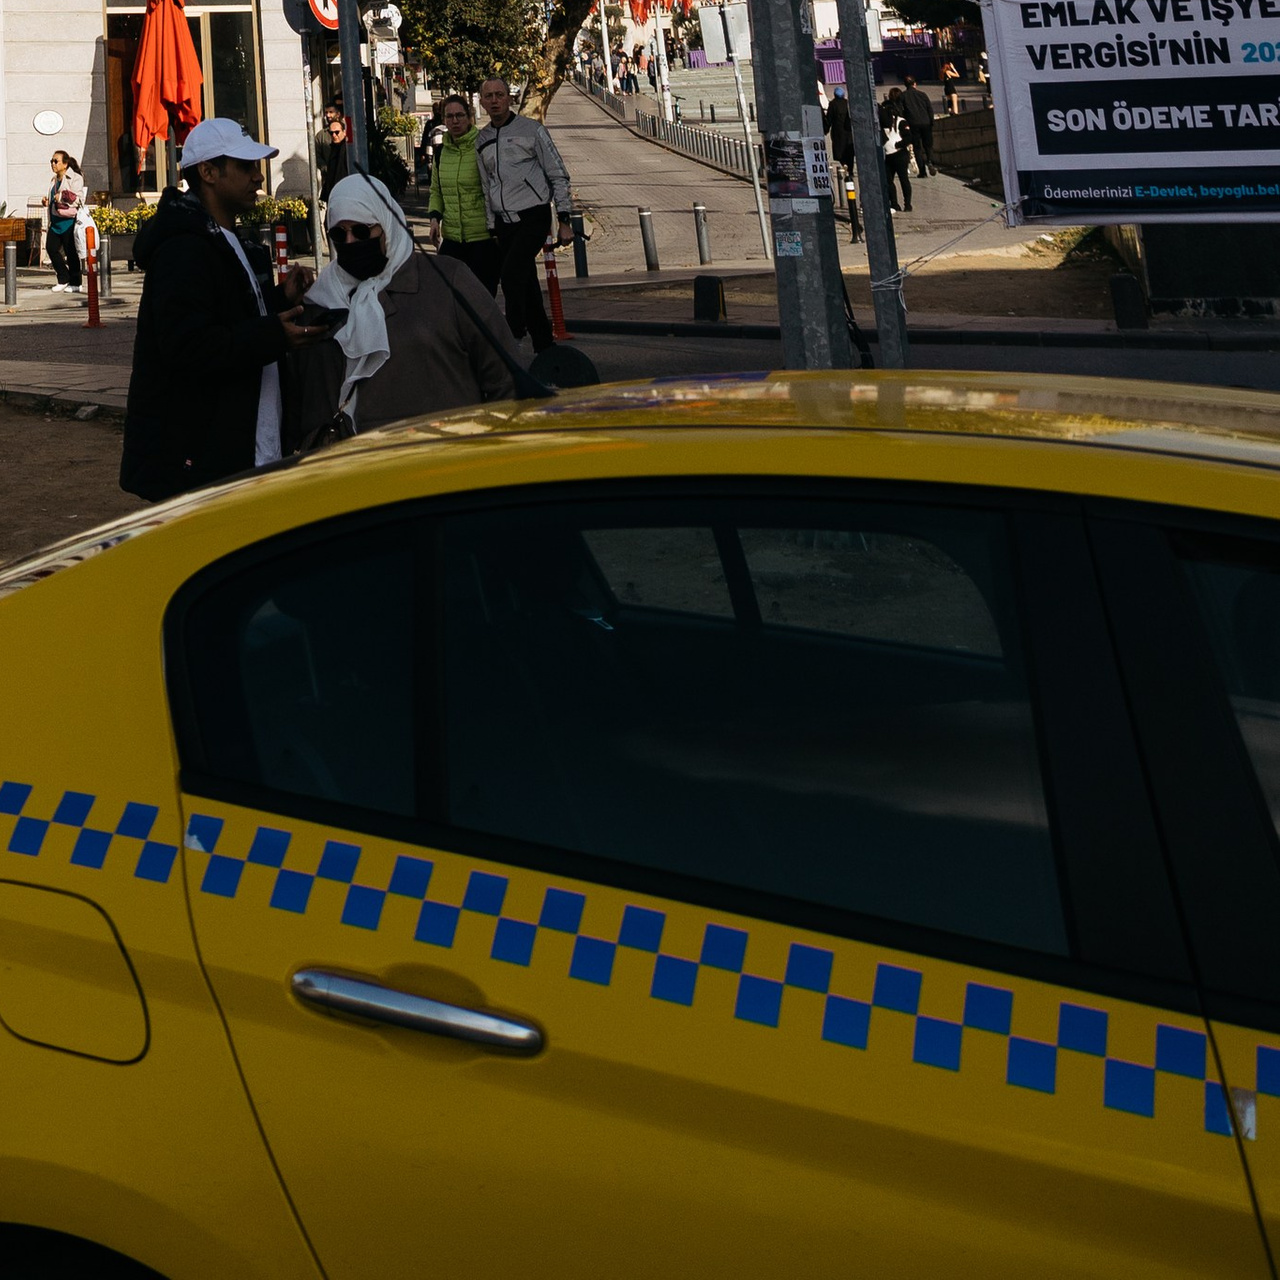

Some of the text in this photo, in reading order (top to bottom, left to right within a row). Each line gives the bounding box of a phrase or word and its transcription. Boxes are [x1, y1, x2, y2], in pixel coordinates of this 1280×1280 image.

[1047, 96, 1280, 132] SON ÖDEME TAR
[1044, 184, 1133, 199] Ödemelerinizi
